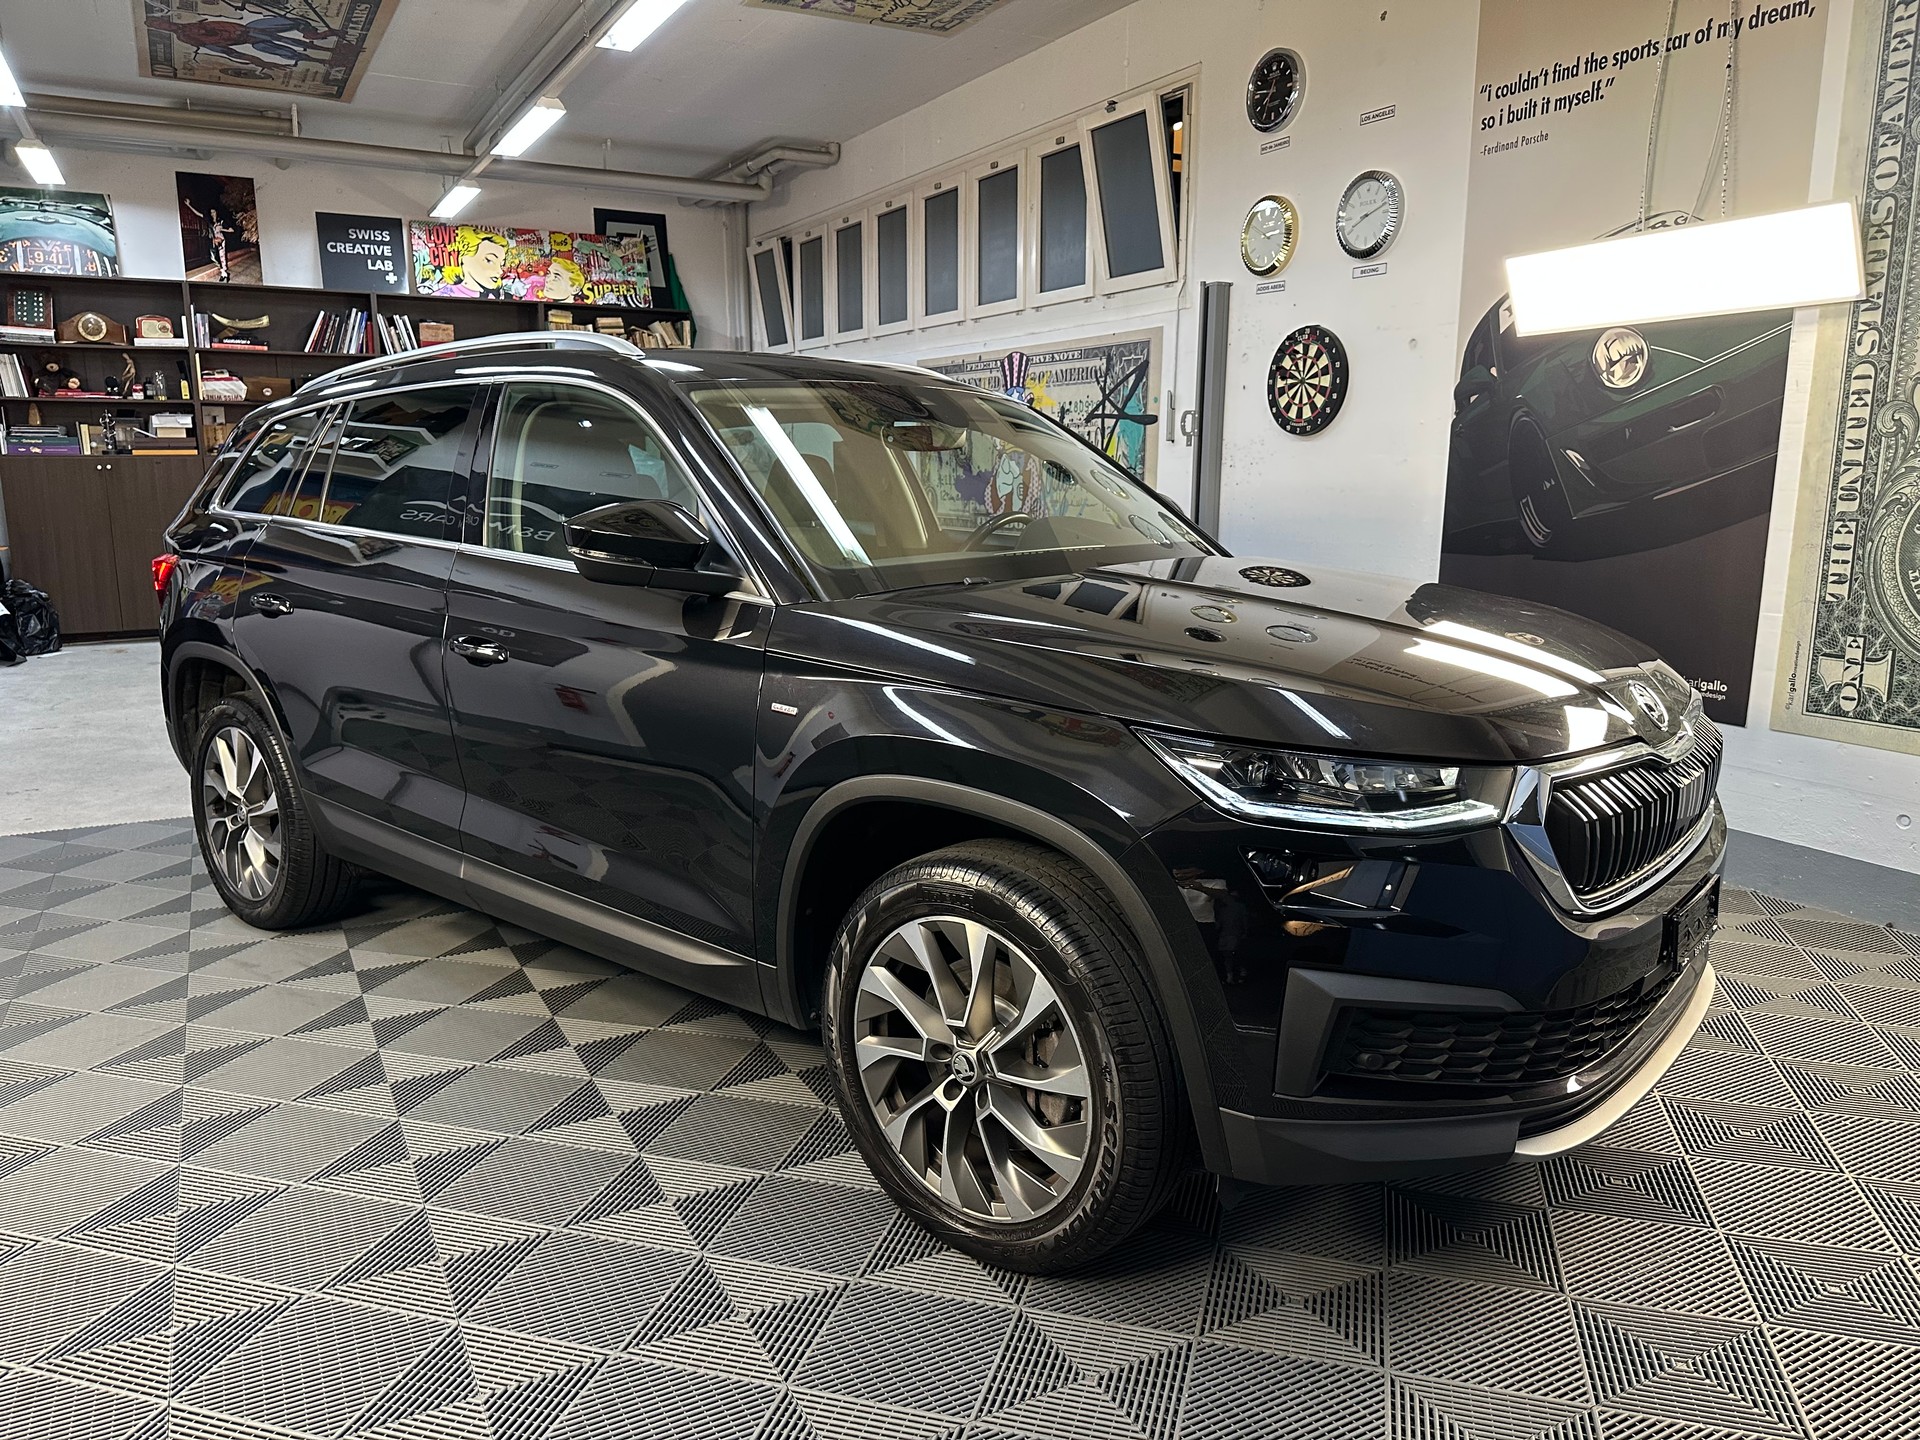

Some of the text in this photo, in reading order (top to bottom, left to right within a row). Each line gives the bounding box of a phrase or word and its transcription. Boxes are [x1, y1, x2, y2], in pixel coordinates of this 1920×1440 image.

[1495, 68, 1549, 99] couldn't
[1552, 58, 1580, 84] find
[1584, 51, 1608, 75] the
[1612, 39, 1660, 70] sports
[1665, 31, 1690, 53] car
[1694, 17, 1714, 44] of
[1717, 16, 1744, 39] my
[1748, 0, 1816, 30] dream,
[1361, 114, 1371, 122] LOS
[1480, 115, 1496, 131] so
[1499, 108, 1504, 127] i
[1507, 98, 1538, 124] built
[1540, 96, 1551, 116] it
[1520, 130, 1549, 147] Porsche
[1873, 132, 1904, 192] OF
[326, 242, 393, 257] CREATIVE
[348, 228, 391, 242] SWISS
[367, 259, 394, 272] LAB
[429, 245, 460, 268] CITY
[1854, 192, 1898, 356] STATES
[1053, 350, 1082, 361] NOTE
[1834, 360, 1878, 515] UNITED
[1825, 519, 1857, 603] THE
[1840, 635, 1865, 712] ONE
